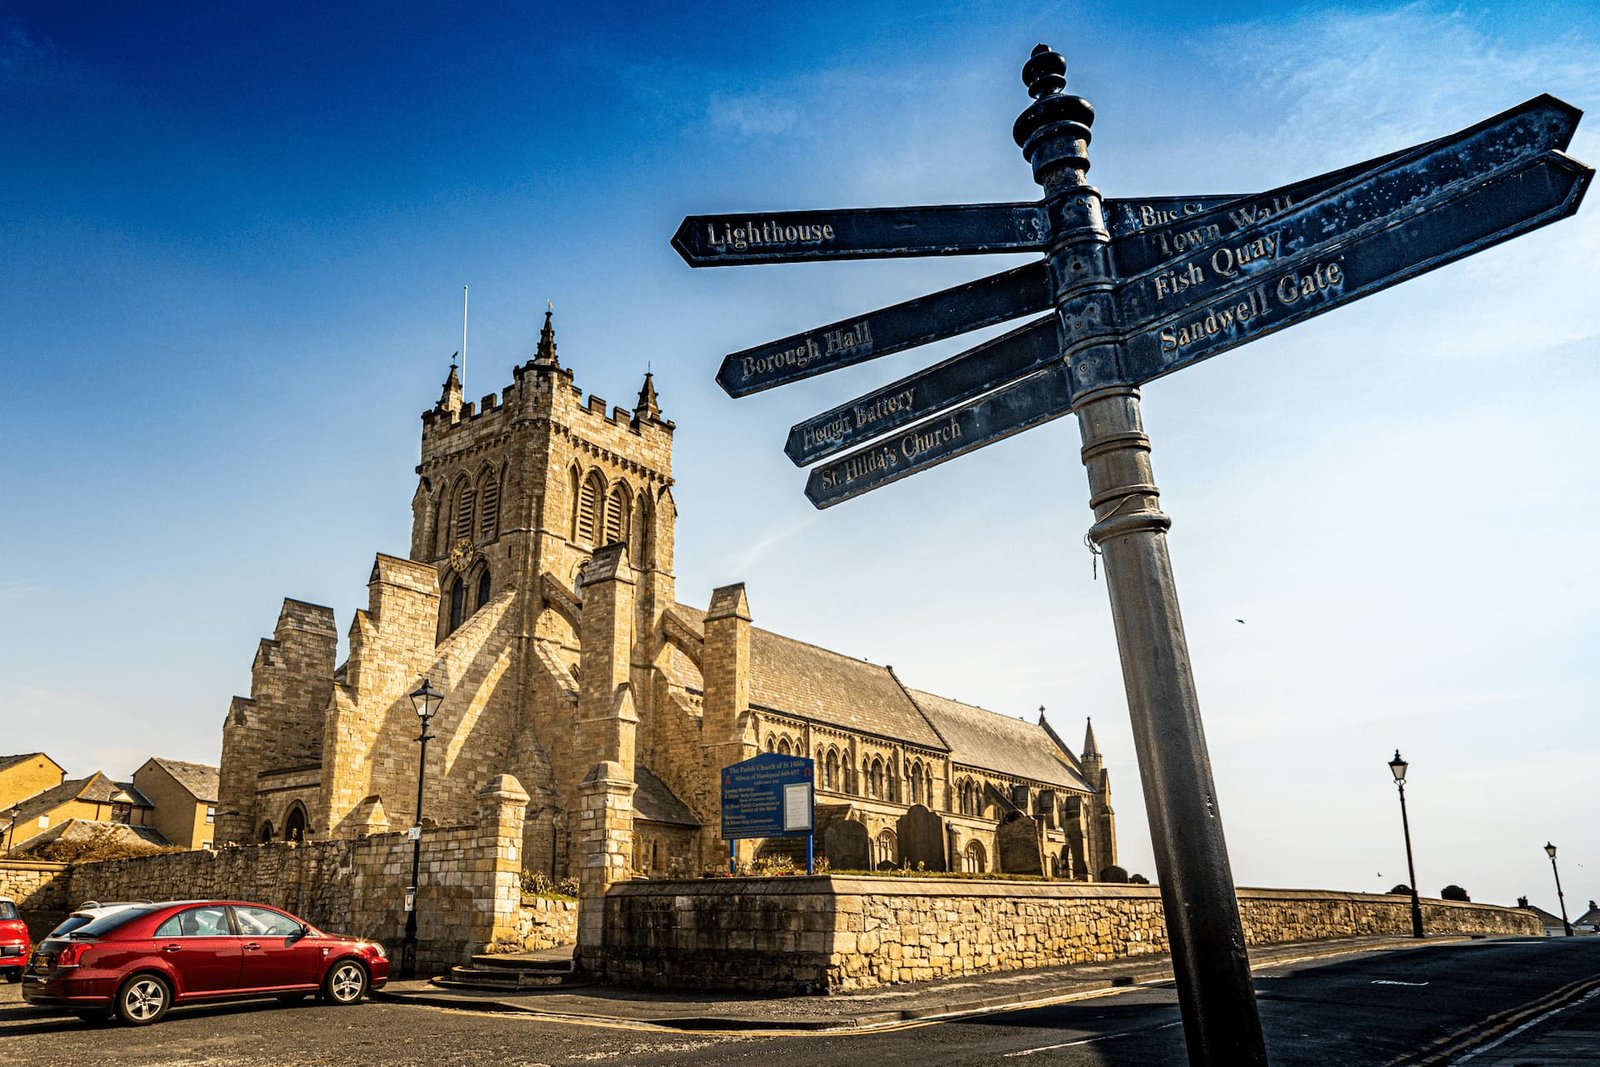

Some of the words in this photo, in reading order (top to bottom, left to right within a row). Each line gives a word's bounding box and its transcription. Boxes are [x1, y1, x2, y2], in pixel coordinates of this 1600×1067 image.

[707, 221, 834, 250] Lighthouse
[1139, 204, 1178, 228] Bus
[1153, 221, 1221, 256] Town
[1228, 194, 1293, 230] Wall
[1153, 261, 1206, 301] Fish
[1211, 229, 1281, 278] Quay
[1159, 285, 1273, 353] Sandwell
[1276, 261, 1344, 304] Gate
[740, 338, 821, 382] Borough
[824, 321, 871, 355] Hall
[855, 387, 916, 429] Battery
[821, 467, 844, 490] St.
[846, 445, 898, 484] Hilda's
[901, 419, 961, 458] Church
[756, 763, 776, 771] Church
